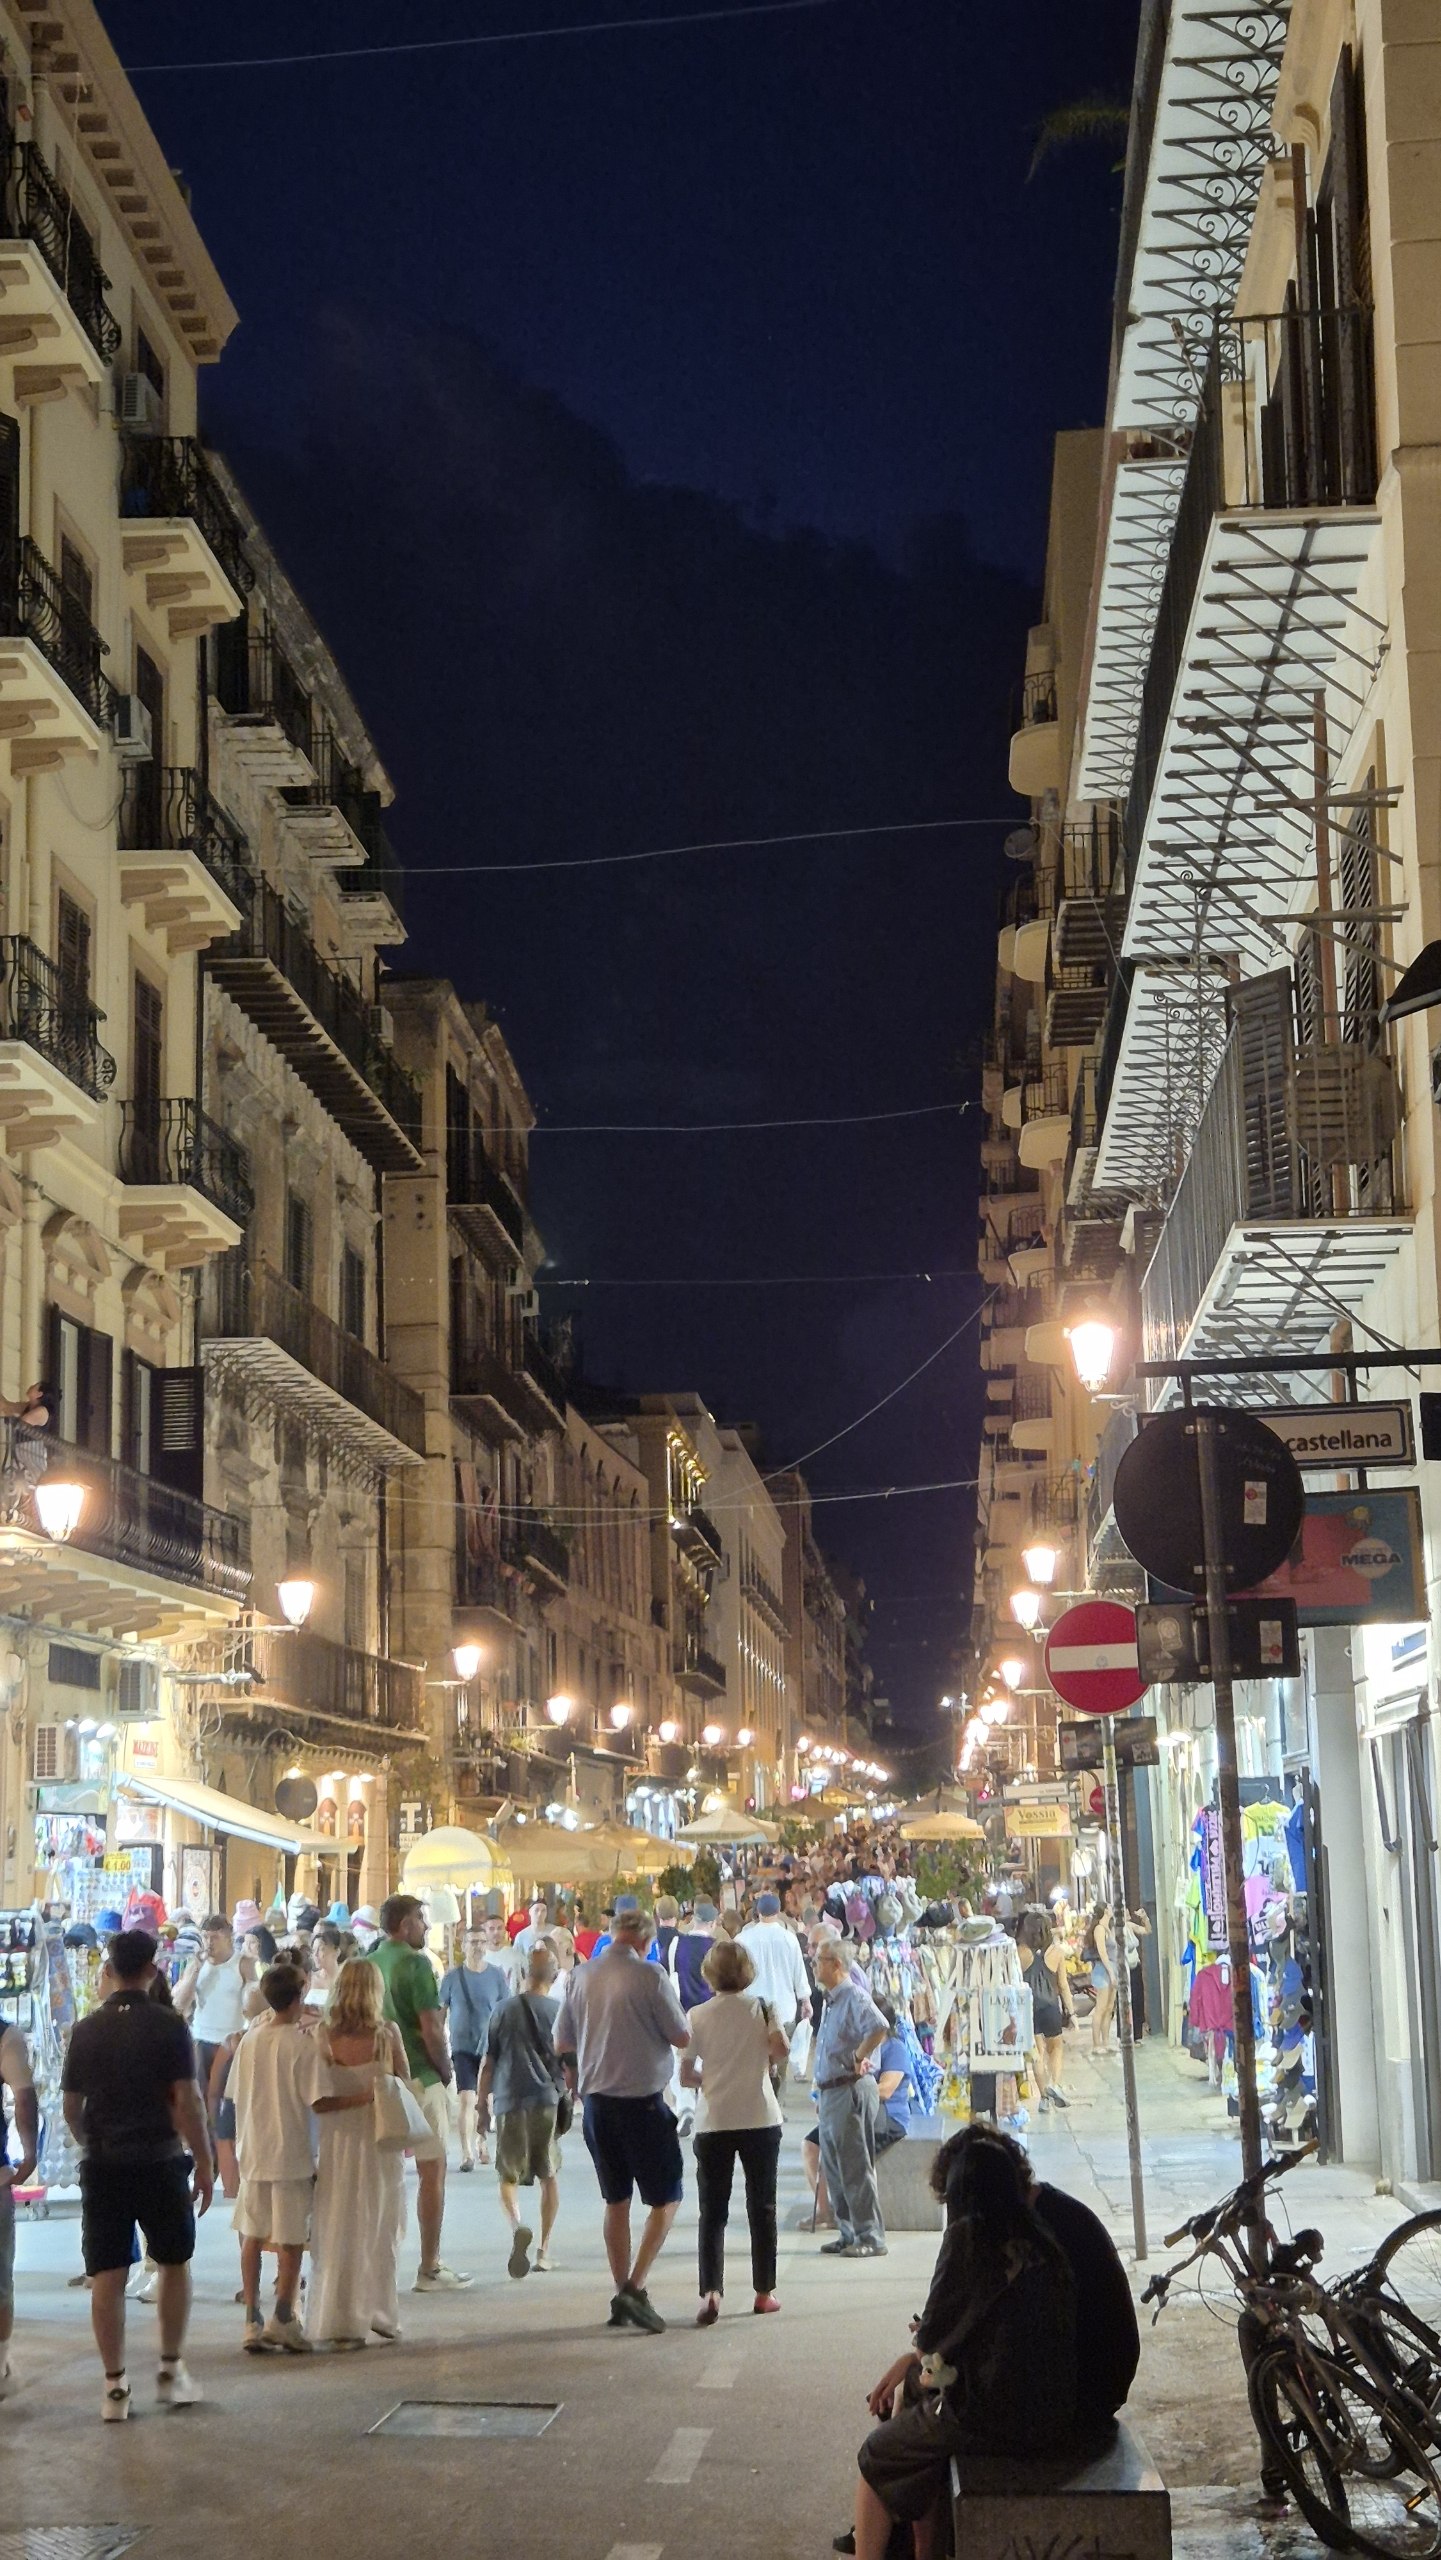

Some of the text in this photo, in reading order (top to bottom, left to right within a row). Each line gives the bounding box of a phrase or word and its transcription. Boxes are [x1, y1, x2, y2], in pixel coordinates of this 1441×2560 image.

[1286, 1429, 1392, 1452] castellana
[1341, 1552, 1401, 1566] MEGA
[1018, 1806, 1056, 1819] Vossia
